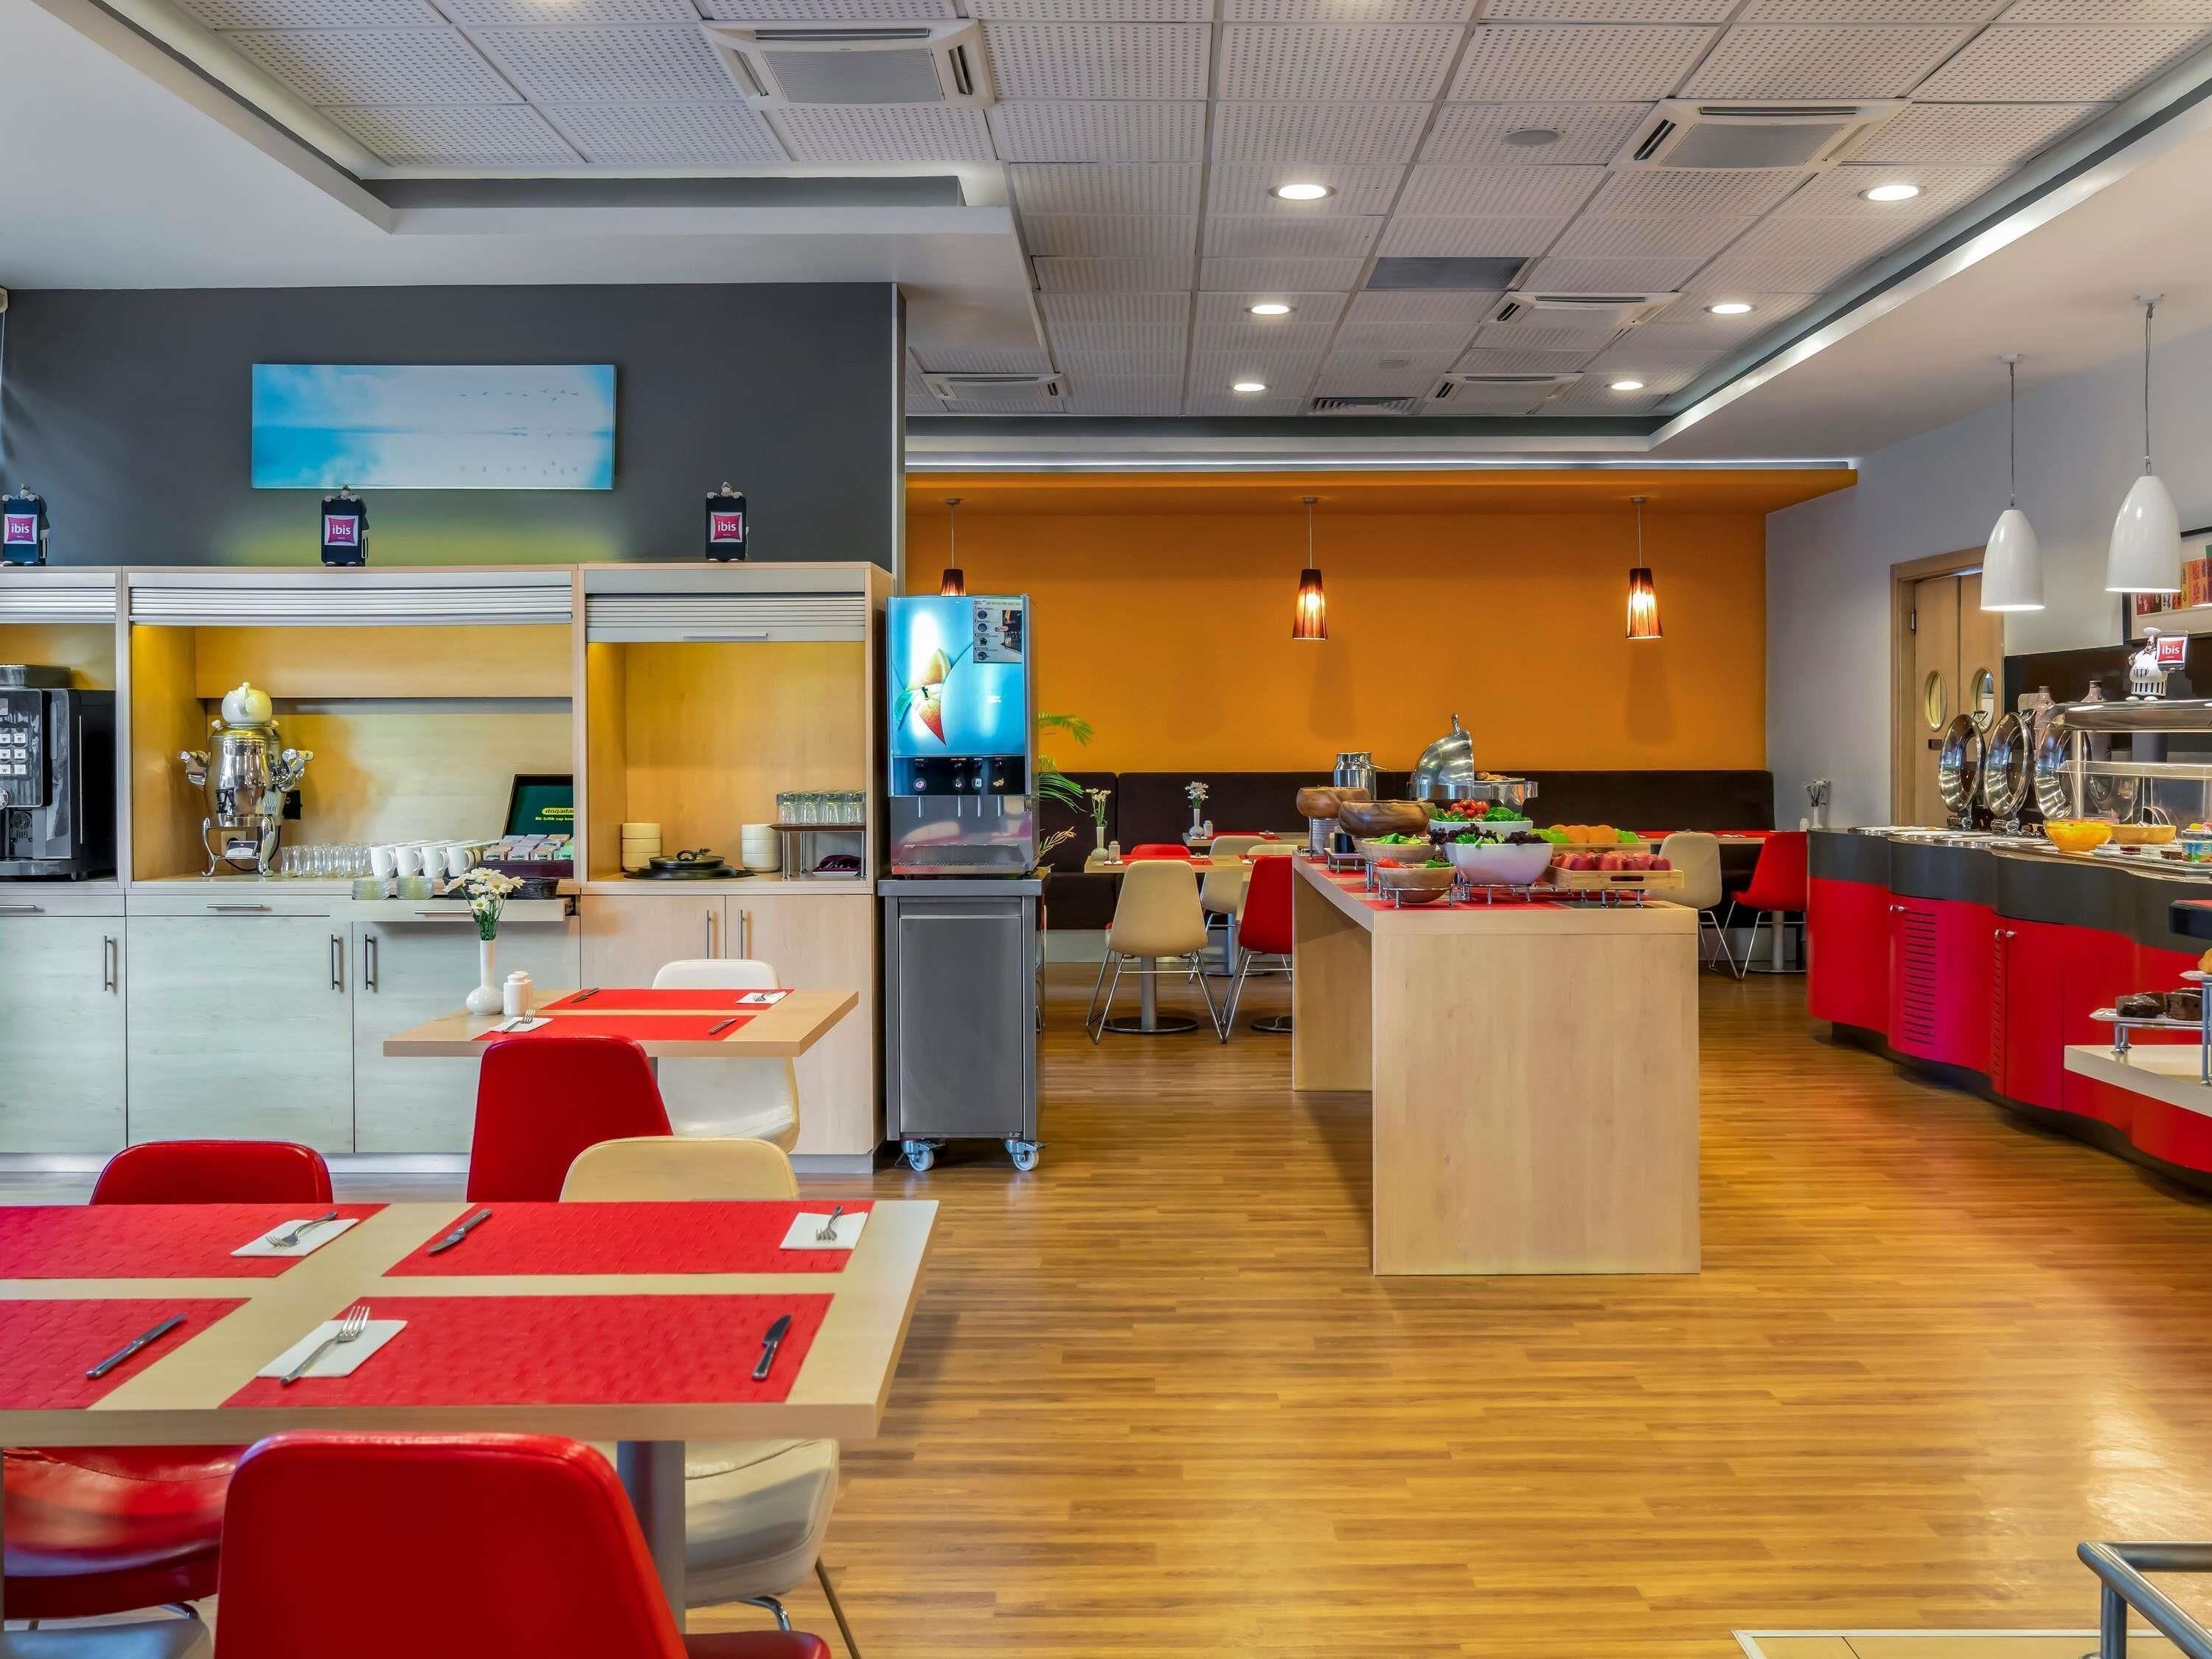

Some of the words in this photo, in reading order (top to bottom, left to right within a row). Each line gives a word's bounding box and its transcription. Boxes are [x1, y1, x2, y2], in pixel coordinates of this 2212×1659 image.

[11, 524, 30, 534] ibis
[332, 524, 351, 535] ibis
[717, 521, 737, 532] ibis
[2162, 645, 2180, 655] ibis
